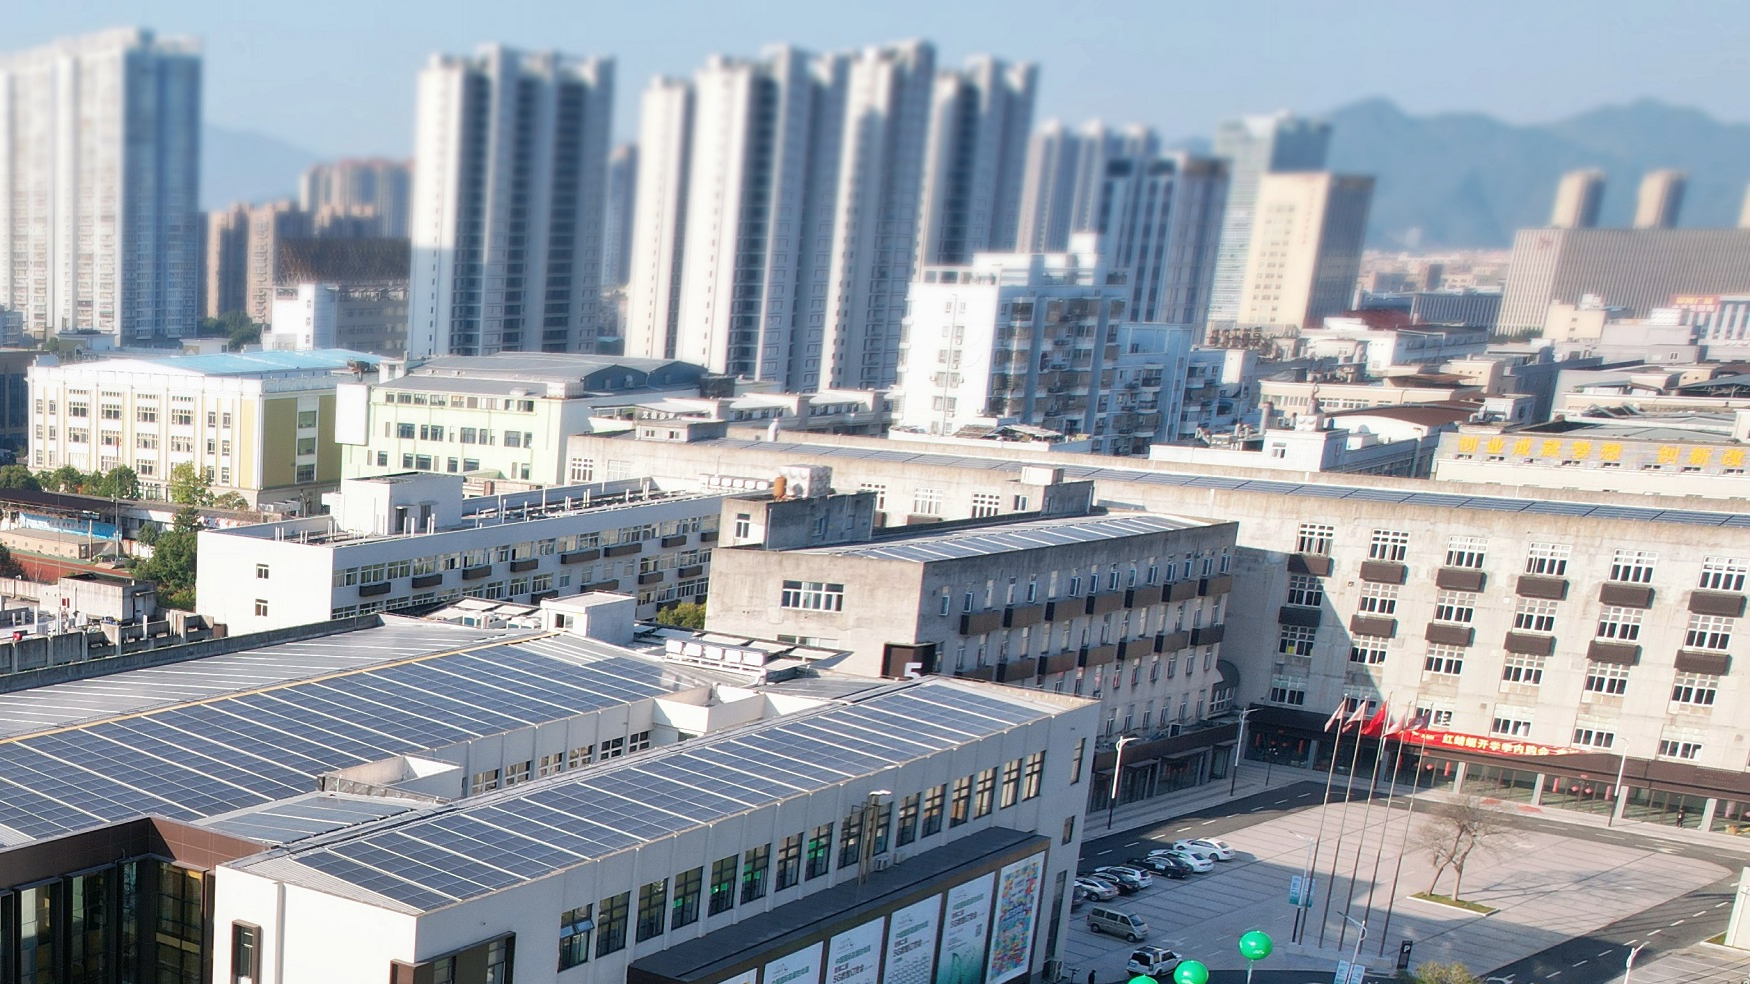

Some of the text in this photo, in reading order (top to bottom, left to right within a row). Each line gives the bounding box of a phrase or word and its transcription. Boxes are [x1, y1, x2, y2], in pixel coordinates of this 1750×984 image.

[1458, 435, 1623, 461] 创业成就梦想
[904, 662, 923, 679] 5
[1403, 945, 1411, 953] P
